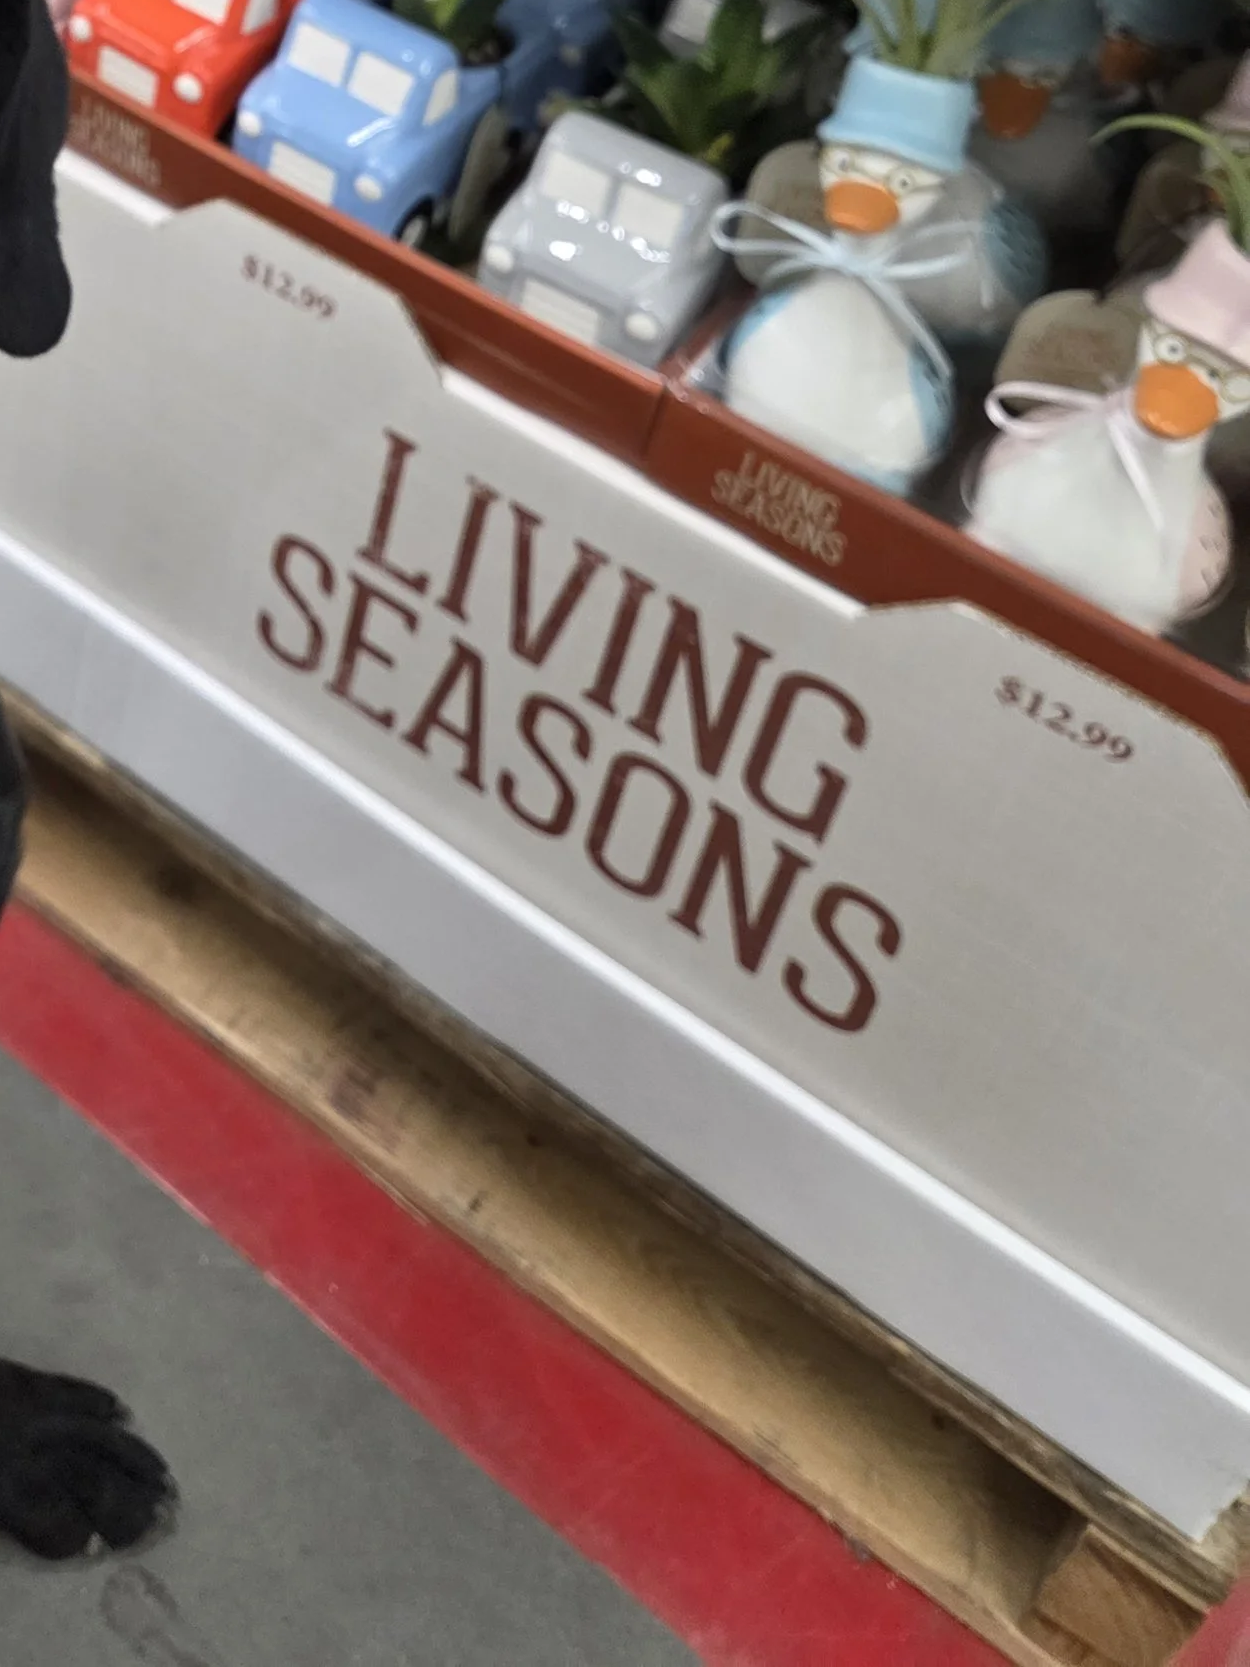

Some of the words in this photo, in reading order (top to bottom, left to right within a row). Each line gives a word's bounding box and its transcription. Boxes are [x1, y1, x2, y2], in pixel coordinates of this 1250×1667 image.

[241, 254, 338, 319] $12.99
[710, 468, 848, 567] SEASONS
[737, 450, 842, 528] LIVING
[355, 426, 869, 843] LIVING
[994, 674, 1134, 762] $12.99
[256, 532, 902, 1034] SEASONS
